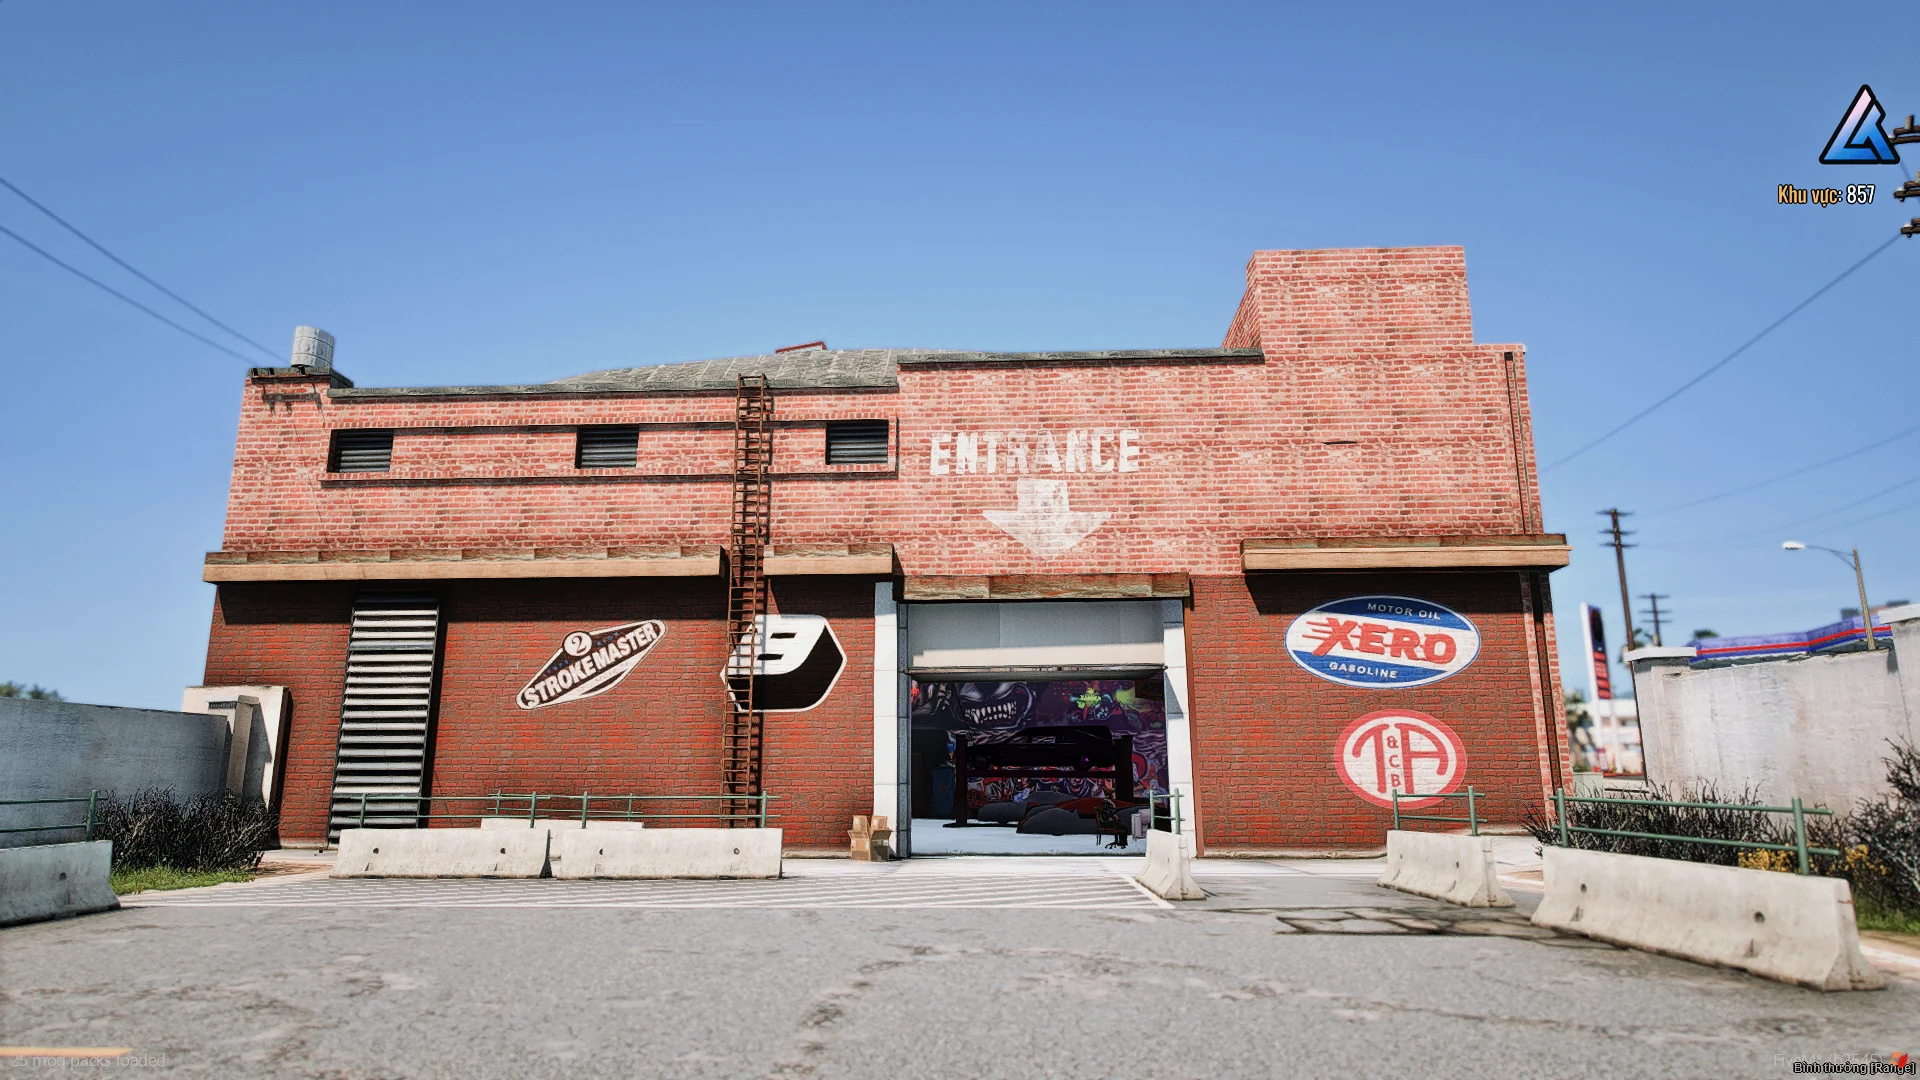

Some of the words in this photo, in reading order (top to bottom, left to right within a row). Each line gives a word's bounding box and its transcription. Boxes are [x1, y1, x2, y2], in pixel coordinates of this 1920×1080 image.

[930, 429, 1141, 475] ENTRANCE
[1367, 602, 1413, 617] MOTOR
[1418, 609, 1441, 620] OIL
[571, 635, 587, 654] 2
[1304, 617, 1457, 665] XERO
[1329, 661, 1399, 679] GASOLINE
